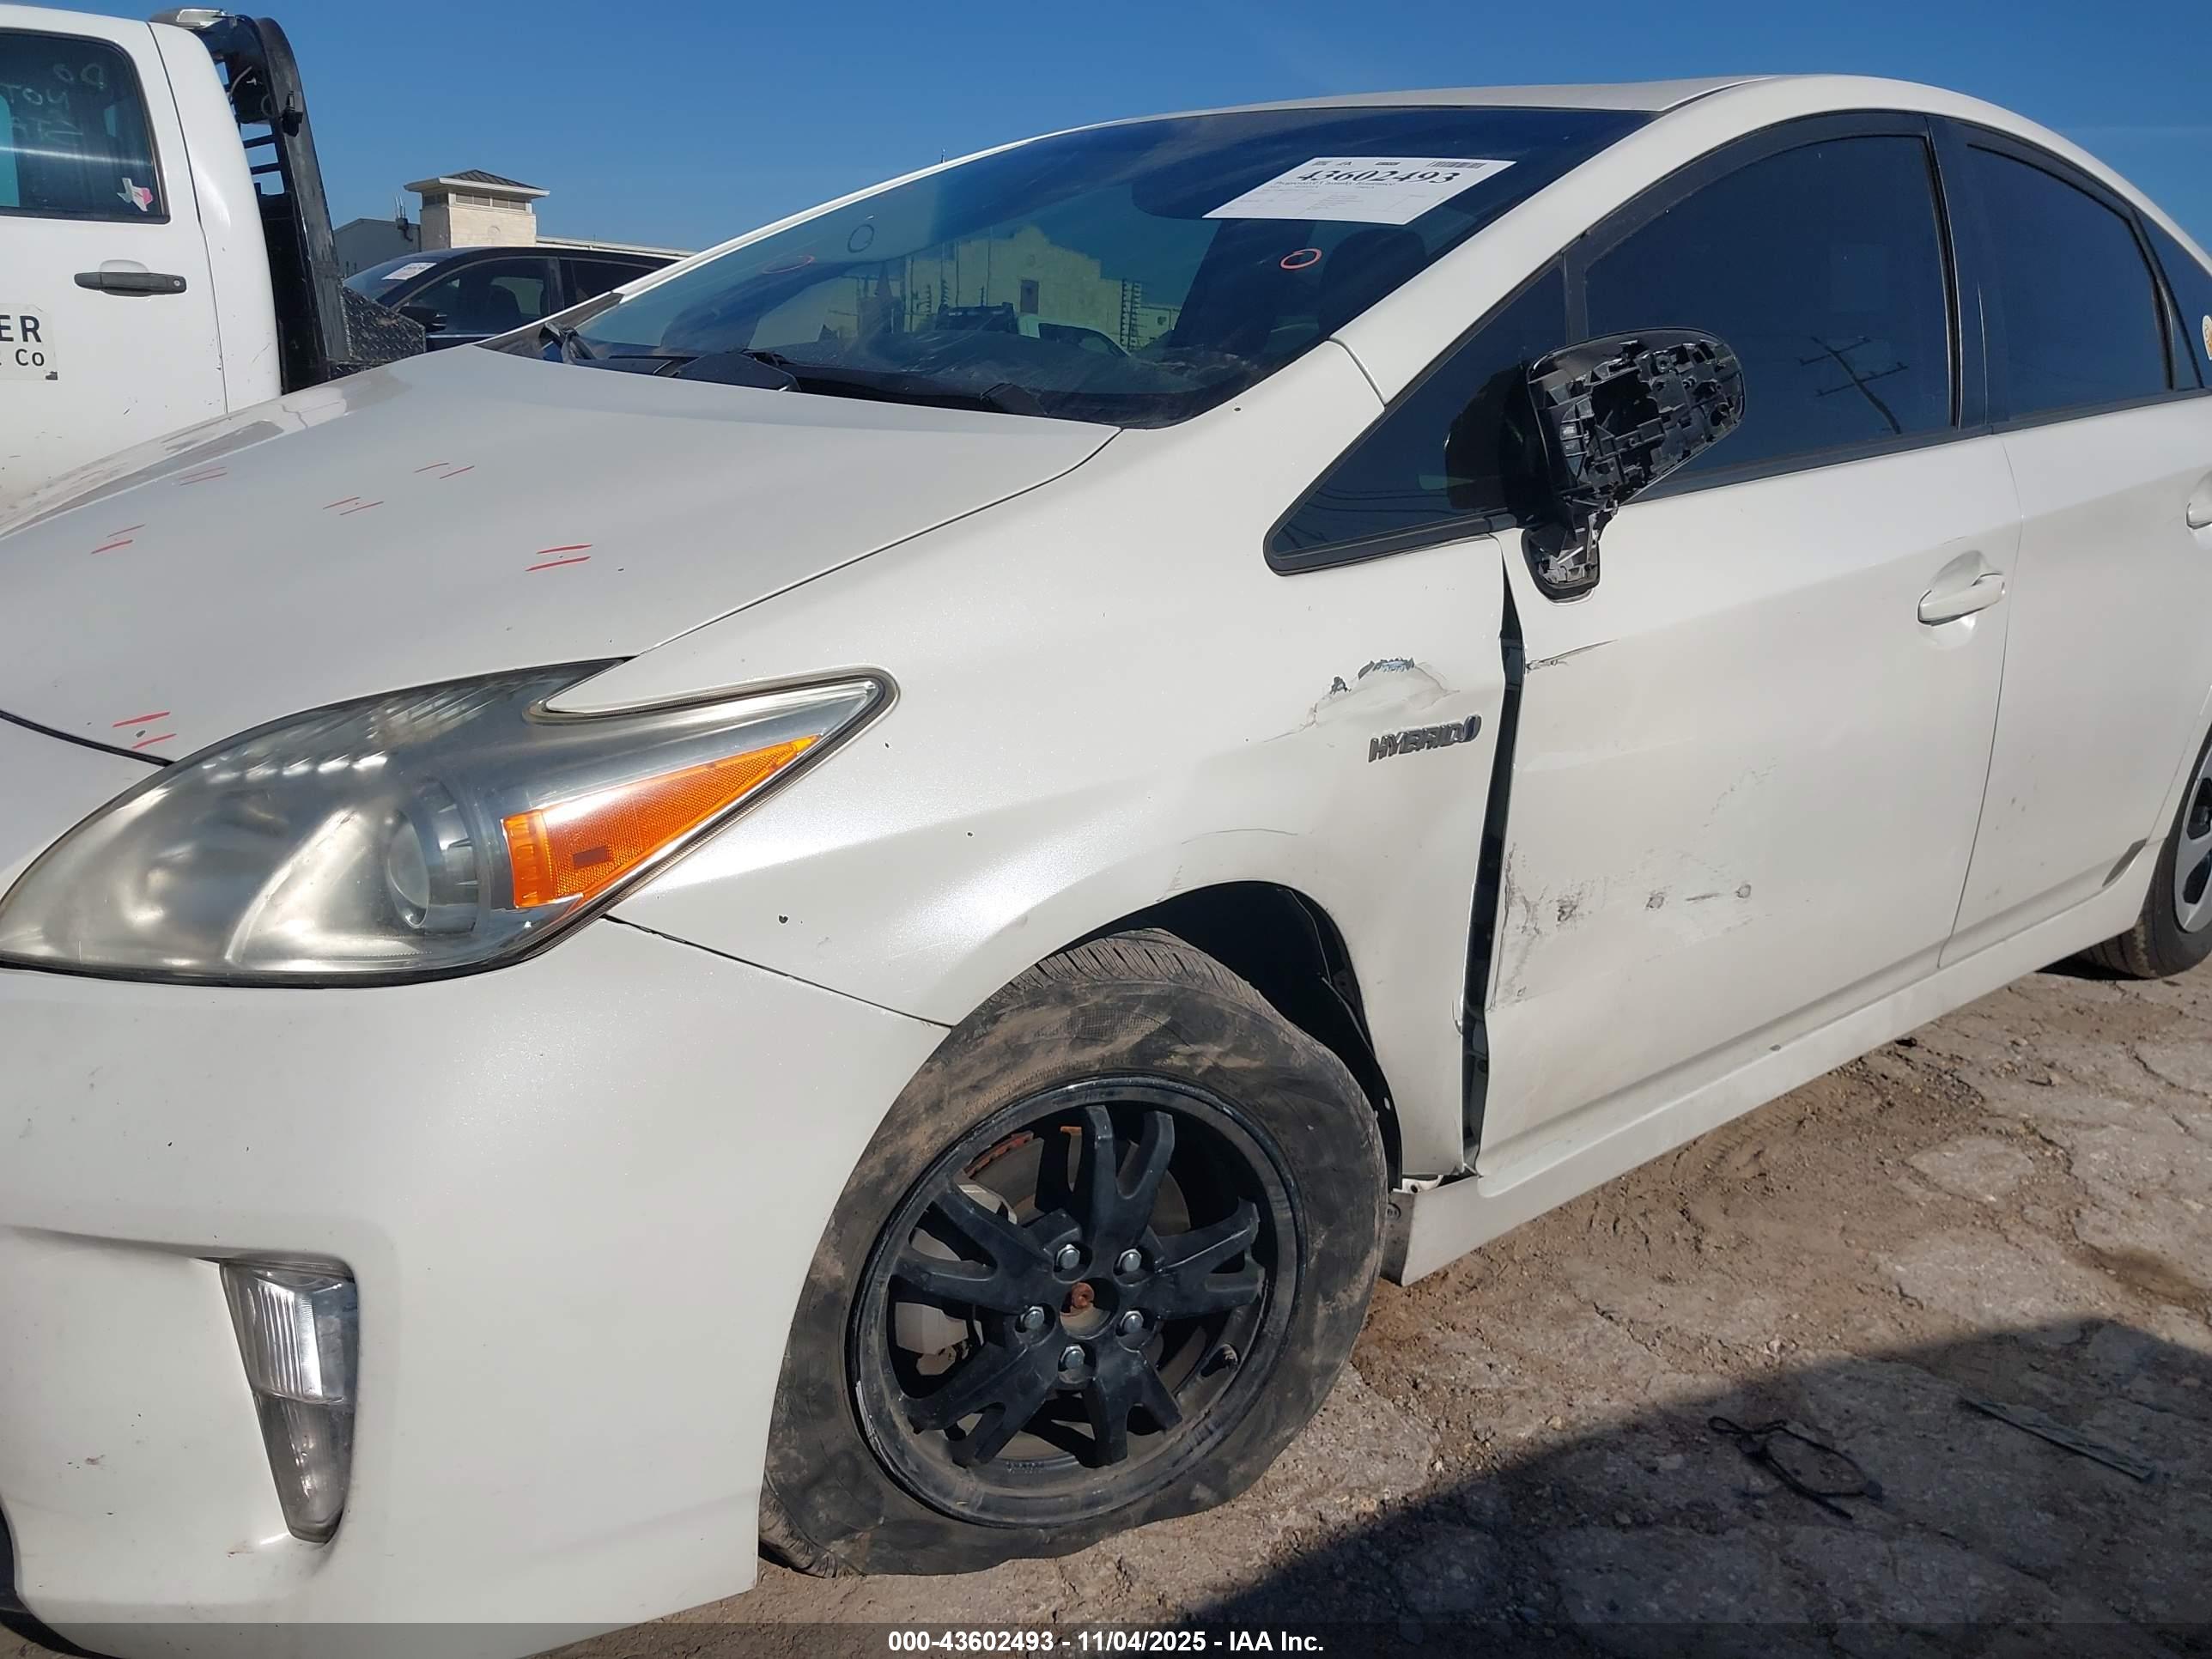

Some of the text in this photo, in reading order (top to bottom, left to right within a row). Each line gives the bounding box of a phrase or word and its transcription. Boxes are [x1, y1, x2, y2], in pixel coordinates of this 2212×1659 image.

[1296, 170, 1461, 184] 43602493
[15, 348, 45, 367] Co
[1368, 720, 1468, 763] HYBRID
